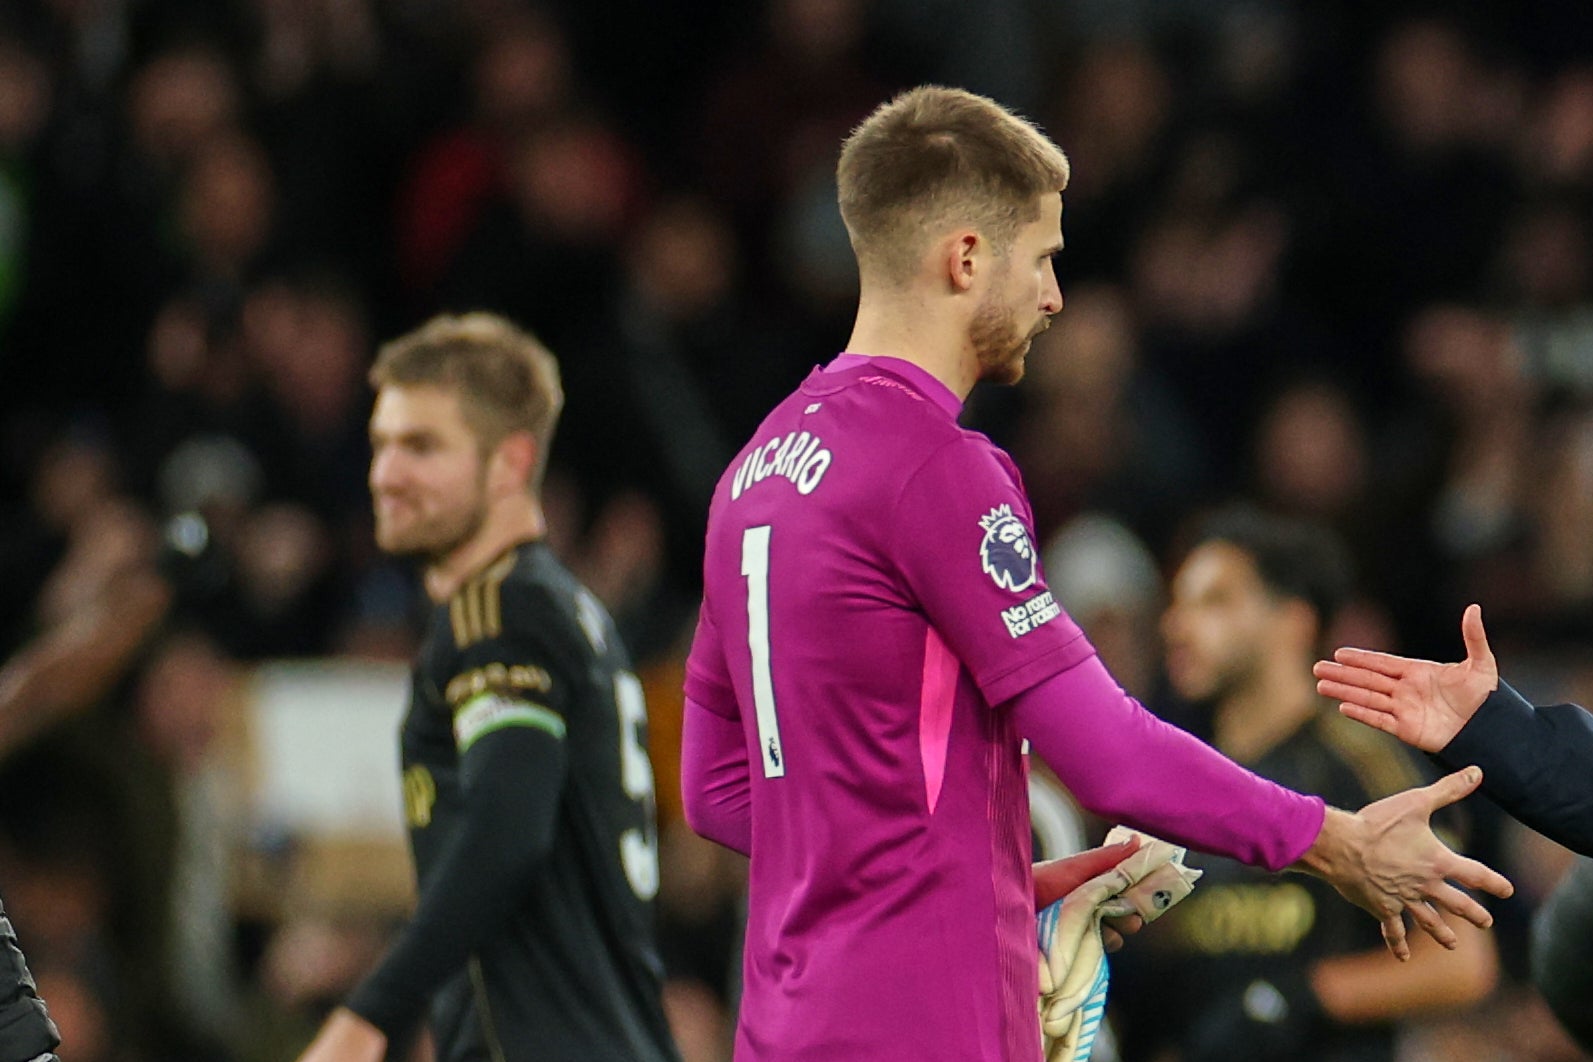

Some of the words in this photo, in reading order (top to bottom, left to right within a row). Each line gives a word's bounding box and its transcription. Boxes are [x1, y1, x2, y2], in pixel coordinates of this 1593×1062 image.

[732, 432, 831, 501] VICARIO
[1001, 606, 1027, 624] No
[741, 525, 784, 778] 1
